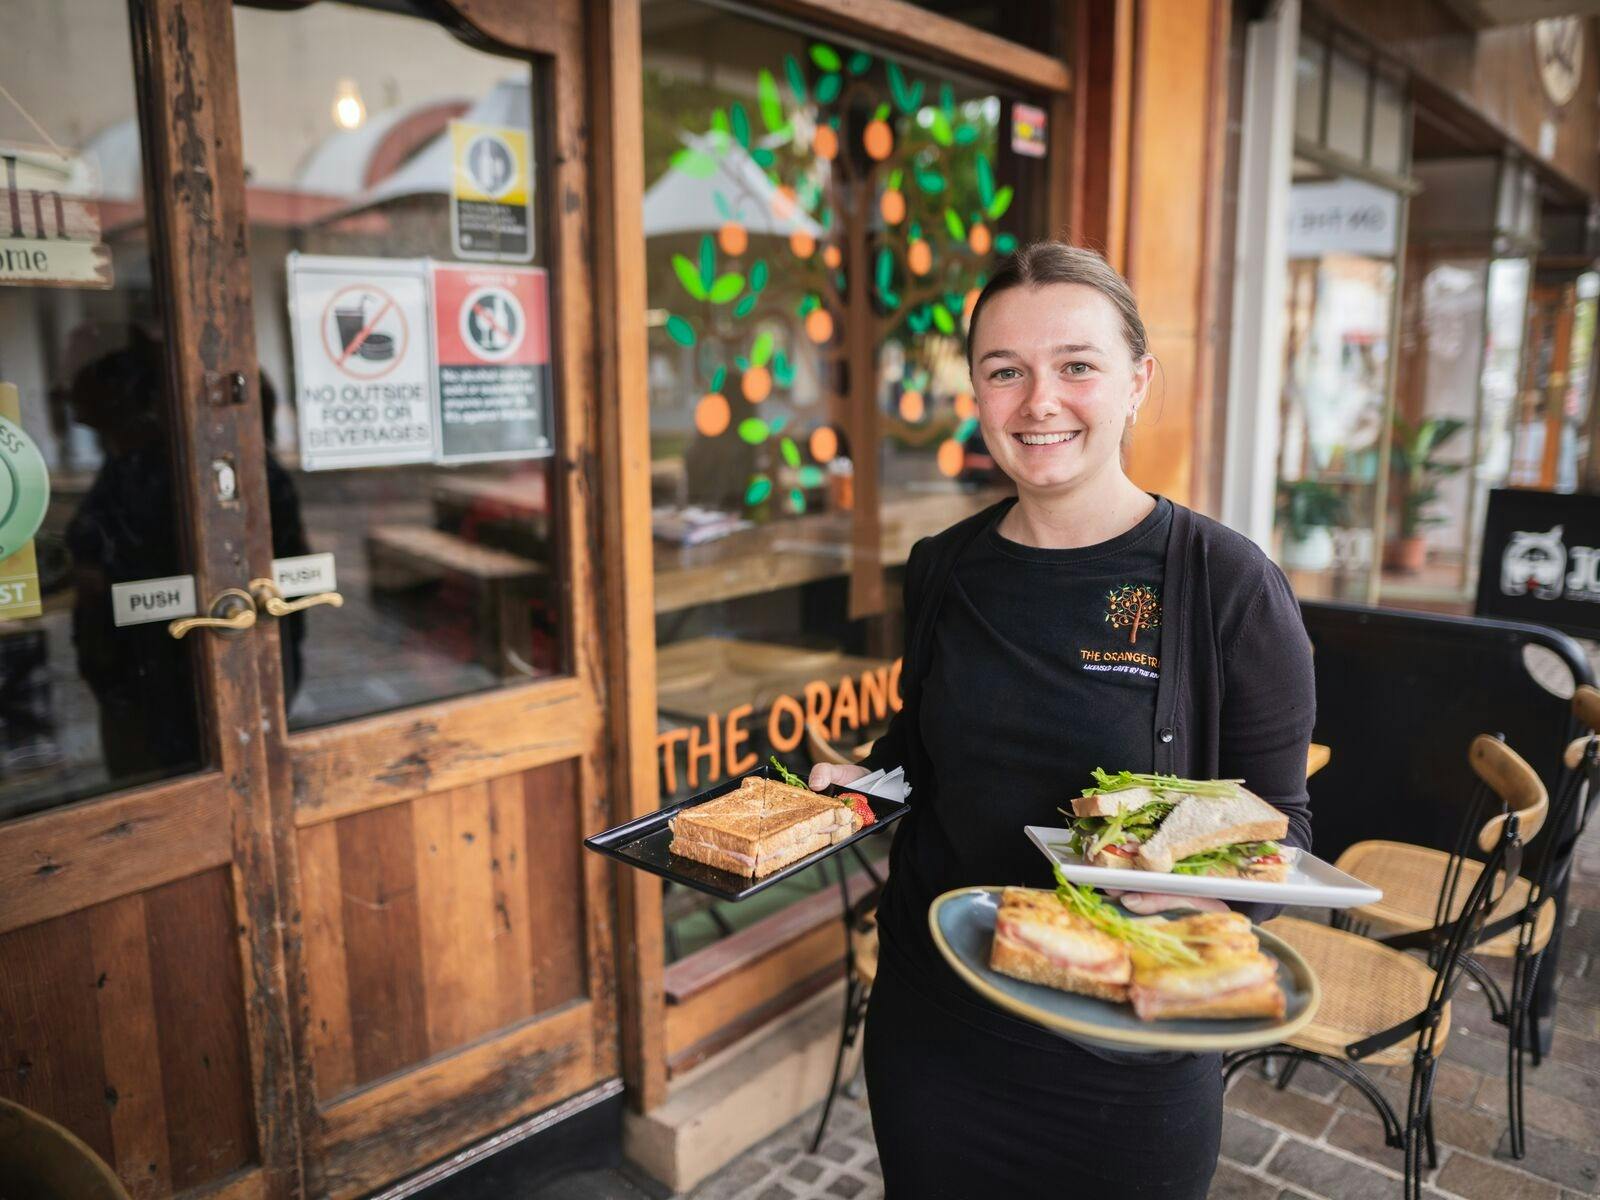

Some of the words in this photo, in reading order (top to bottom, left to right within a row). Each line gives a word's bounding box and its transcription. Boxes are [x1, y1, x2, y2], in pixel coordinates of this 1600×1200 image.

[304, 385, 336, 402] NO
[341, 383, 423, 402] OUTSIDE
[322, 404, 378, 423] FOOD
[384, 404, 412, 421] OR
[309, 424, 429, 447] BEVERAGES
[279, 568, 322, 584] PUSH
[130, 589, 181, 611] PUSH
[1080, 650, 1102, 662] THE
[1083, 663, 1112, 672] LICENSED
[656, 703, 758, 795] THE
